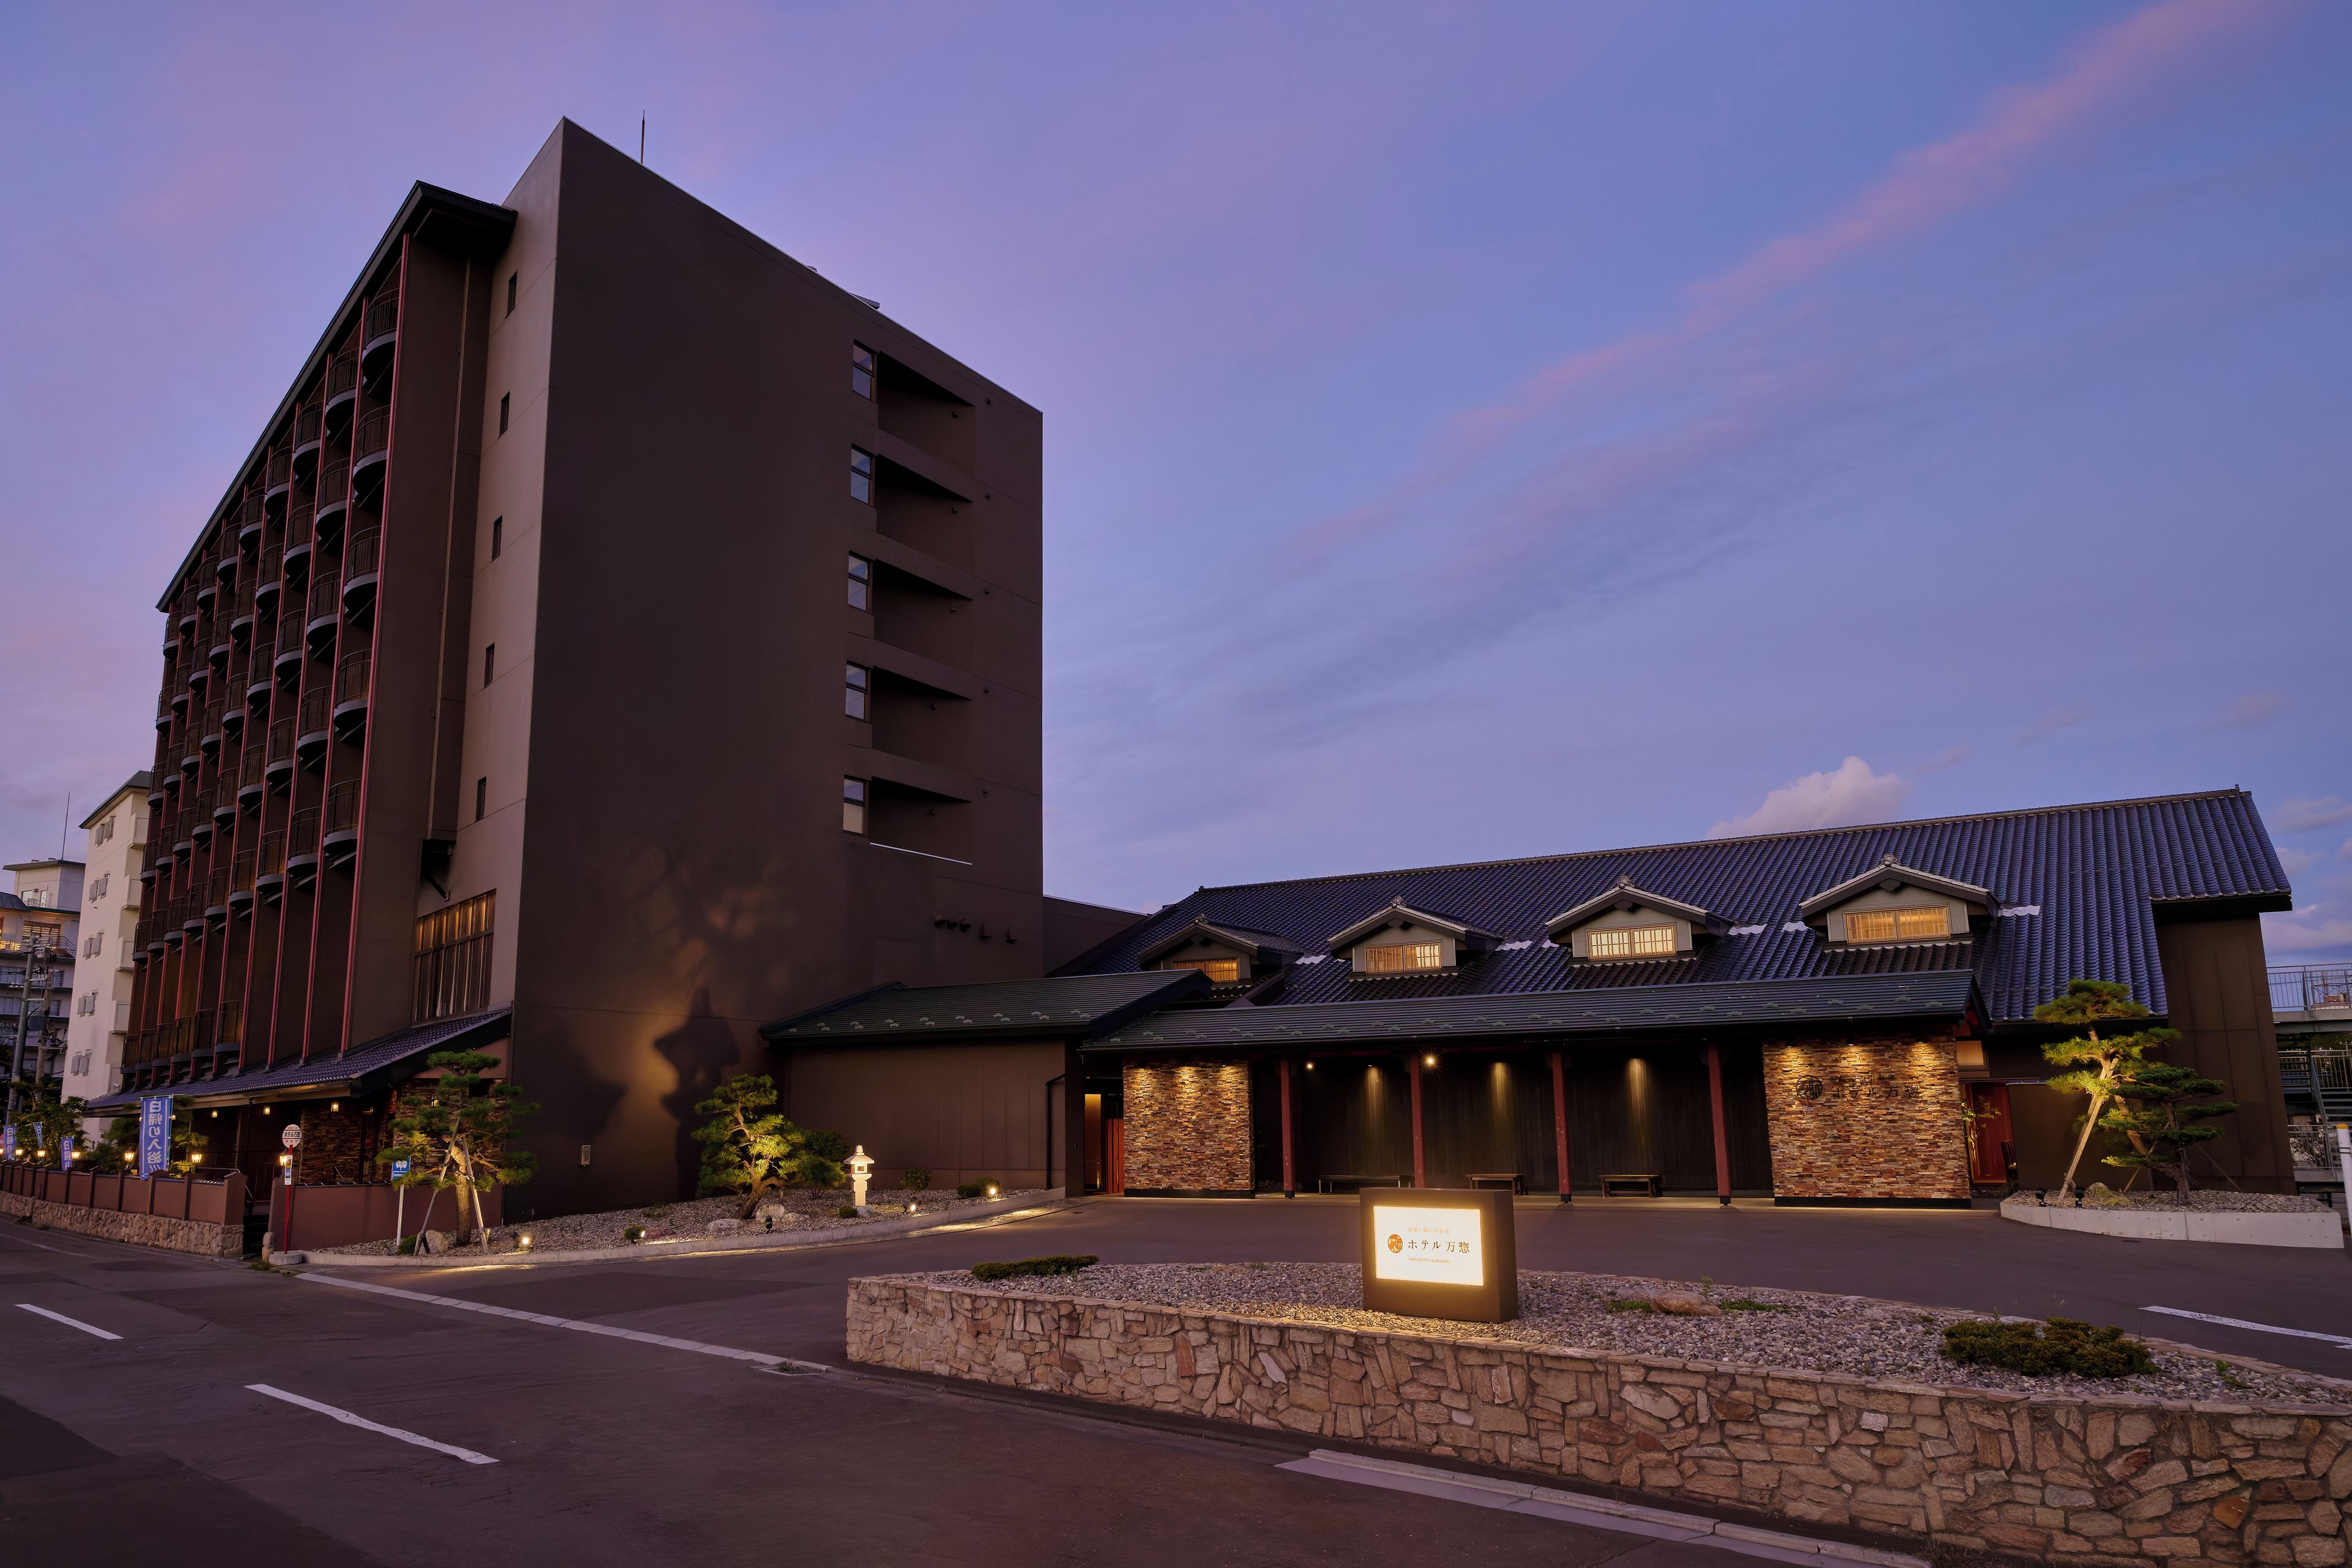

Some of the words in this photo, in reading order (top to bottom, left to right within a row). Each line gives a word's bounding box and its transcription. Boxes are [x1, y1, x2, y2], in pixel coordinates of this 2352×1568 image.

[1408, 1240, 1470, 1253] ホテル万惣
